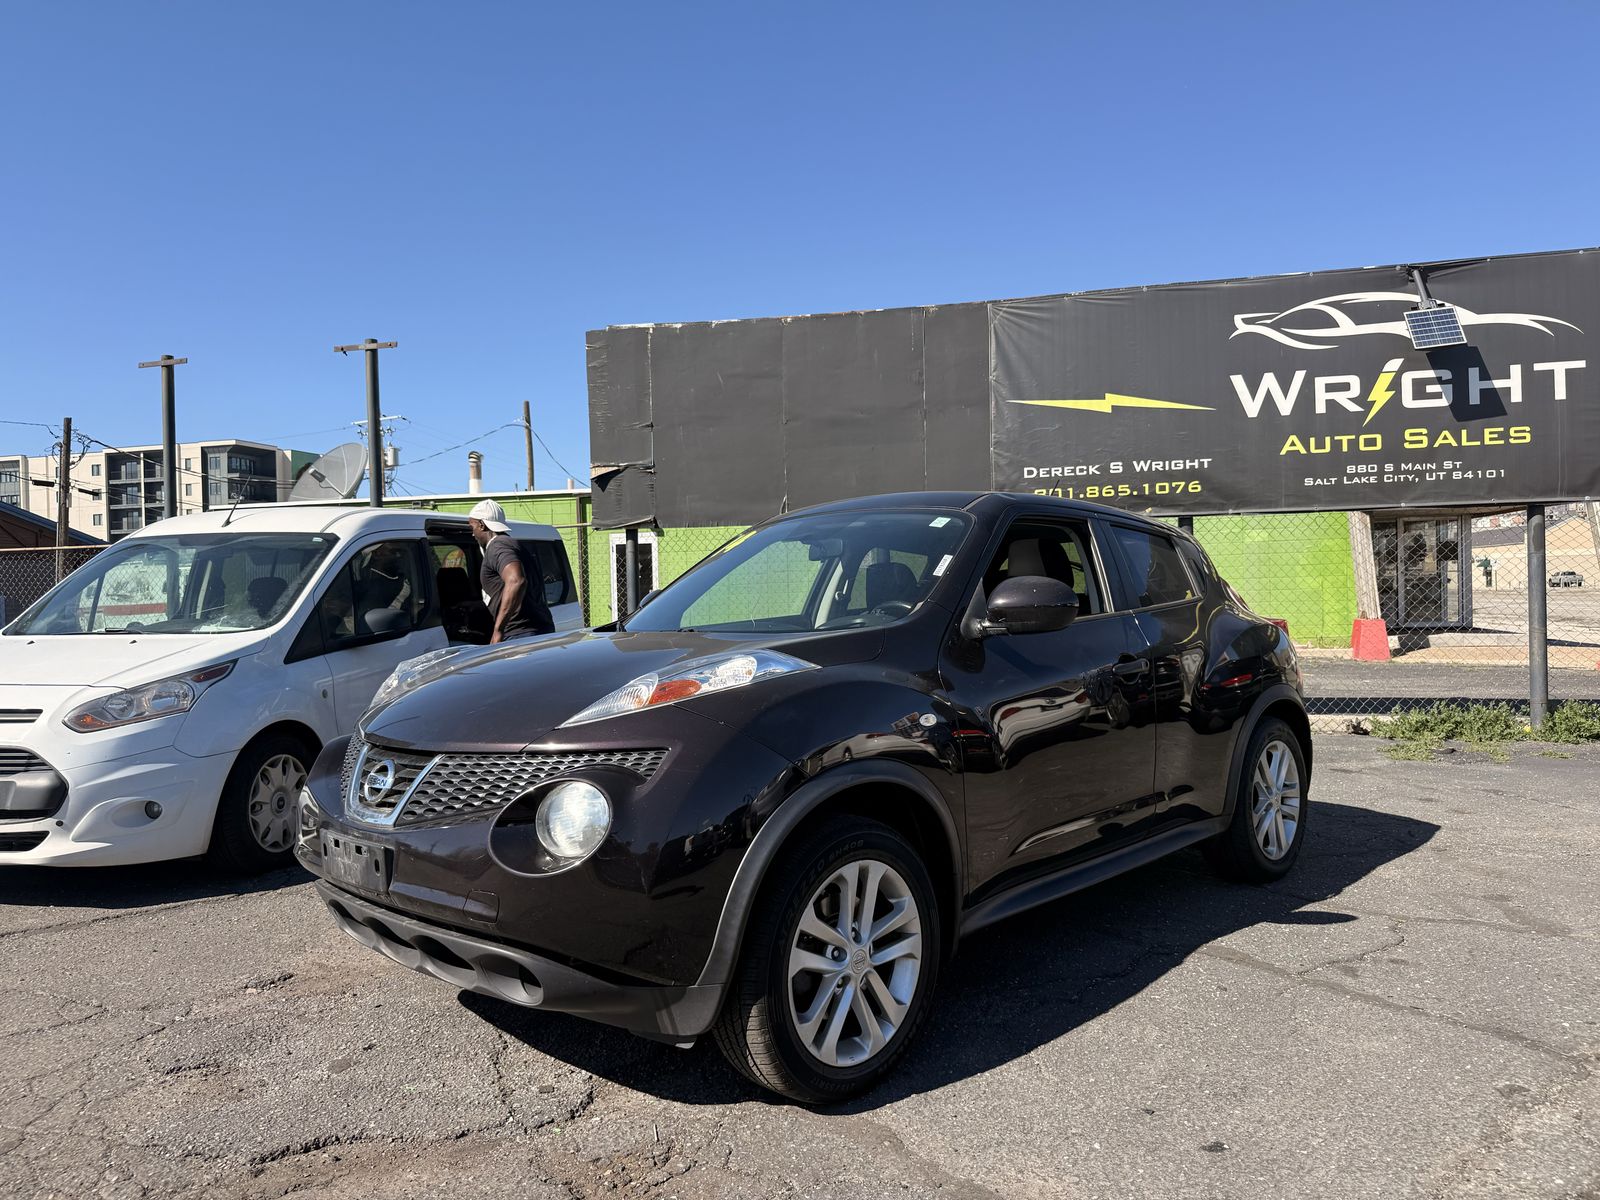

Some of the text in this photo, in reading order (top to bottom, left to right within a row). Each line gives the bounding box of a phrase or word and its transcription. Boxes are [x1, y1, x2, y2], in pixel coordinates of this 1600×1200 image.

[1229, 358, 1587, 426] WRIGHT
[1280, 426, 1532, 456] AUTO SALES
[1023, 458, 1213, 479] DERECK S WRIGHT
[1304, 469, 1505, 486] SALT LAKE CITY, UT 84101
[1346, 461, 1463, 474] 880 S MAIN ST
